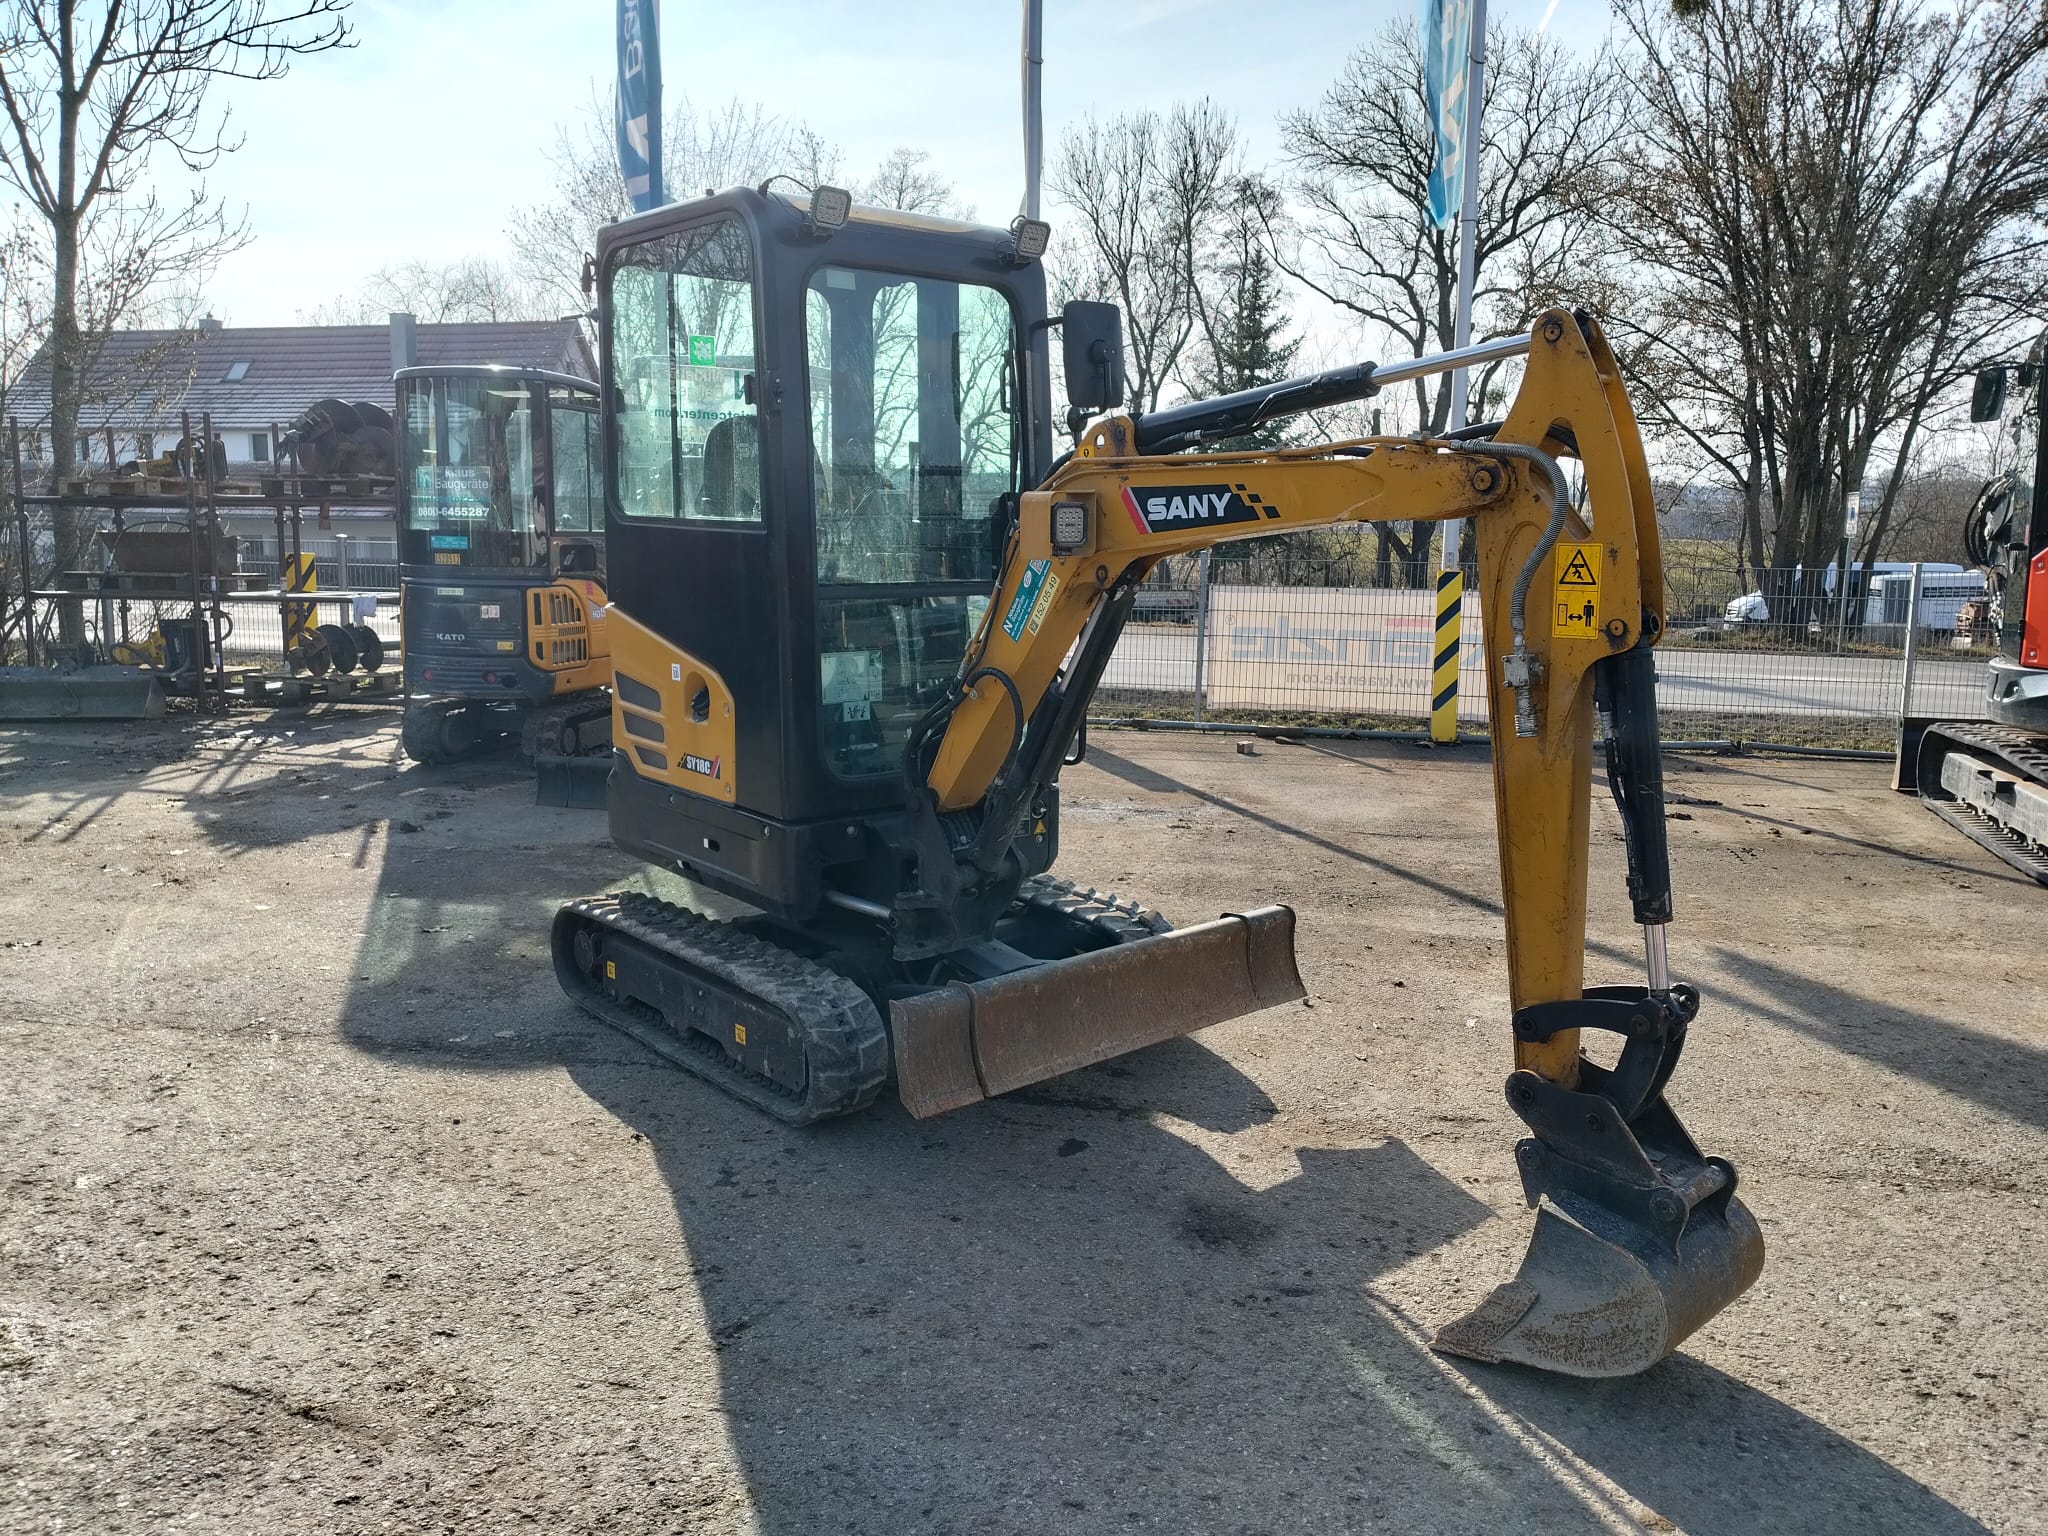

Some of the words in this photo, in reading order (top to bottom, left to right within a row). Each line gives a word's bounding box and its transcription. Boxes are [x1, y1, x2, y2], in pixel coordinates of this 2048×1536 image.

[1147, 492, 1232, 521] SANY
[1042, 589, 1052, 603] 05
[436, 632, 466, 642] KATO
[686, 755, 711, 775] SY18C
